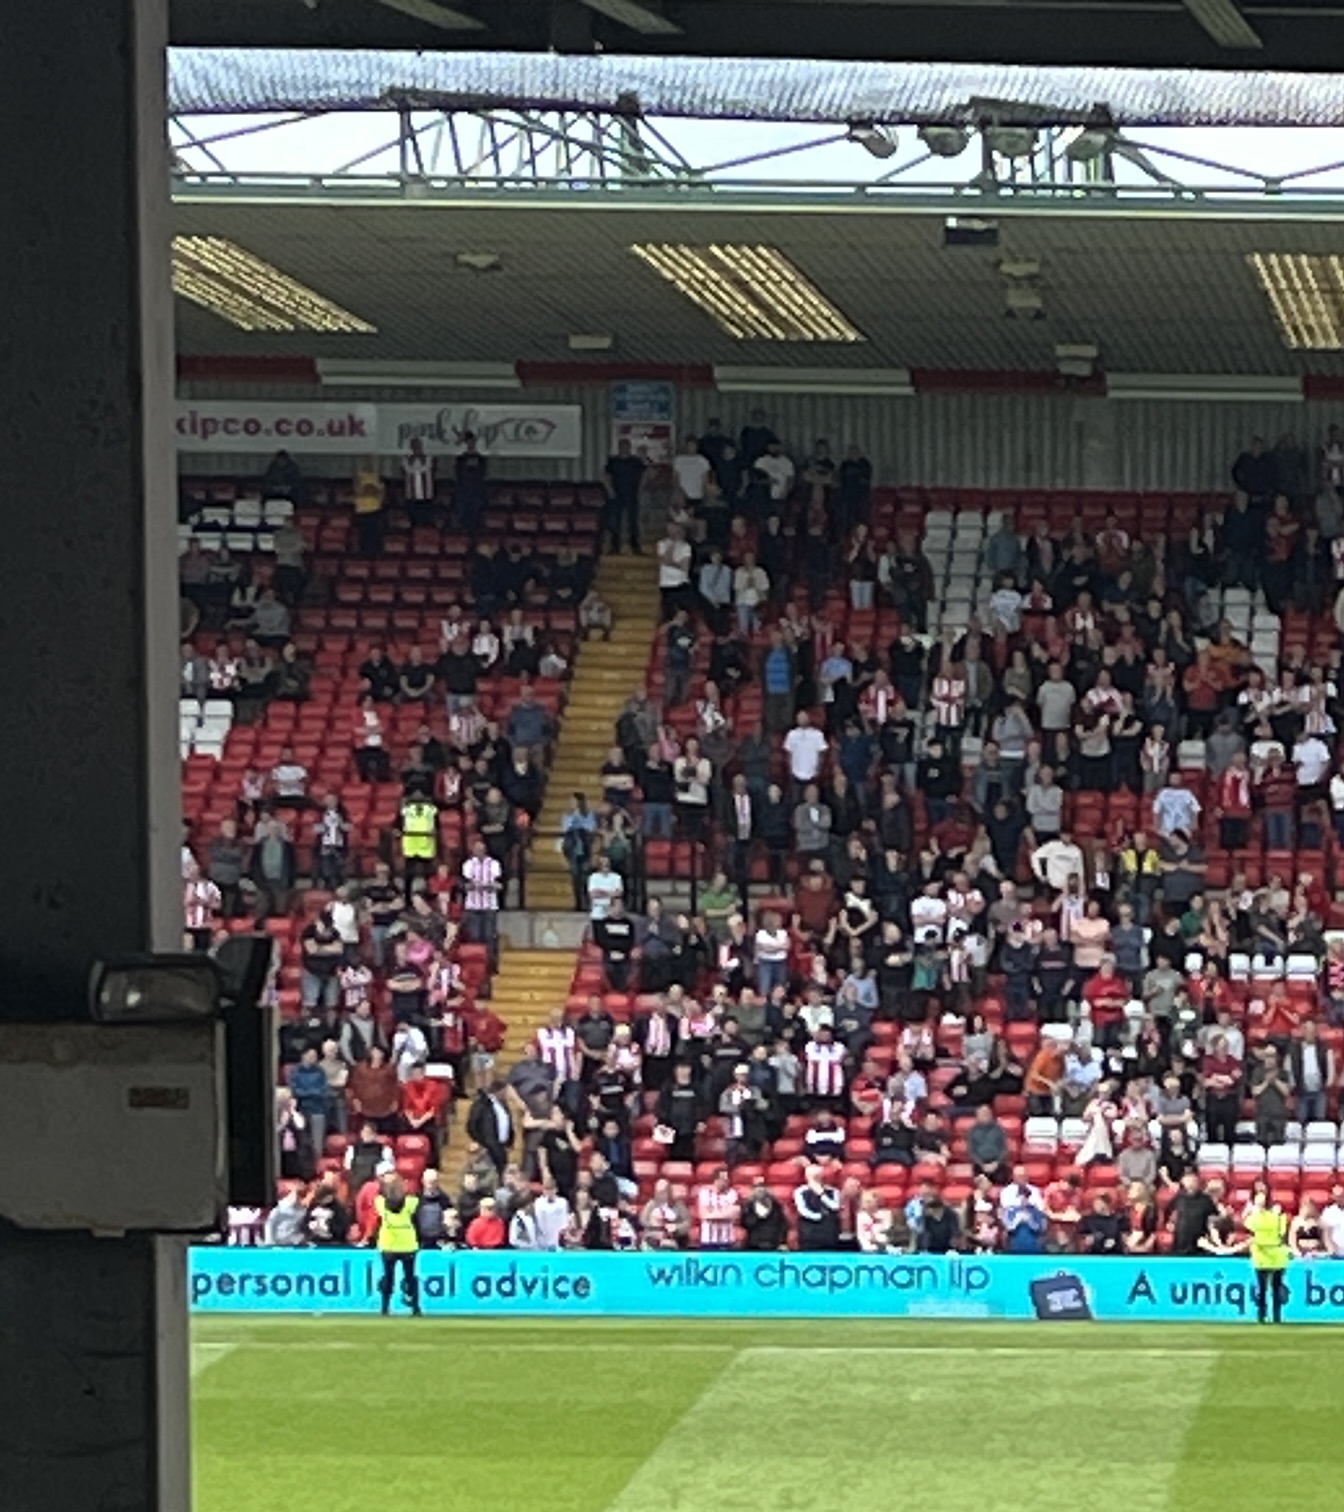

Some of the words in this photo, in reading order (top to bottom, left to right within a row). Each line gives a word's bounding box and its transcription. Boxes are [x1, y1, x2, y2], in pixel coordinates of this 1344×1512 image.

[191, 1260, 352, 1308] personal
[471, 1264, 592, 1299] advice
[648, 1259, 742, 1287] wilkin
[754, 1260, 938, 1294] chapman
[949, 1260, 990, 1293] llp
[1128, 1270, 1155, 1304] A
